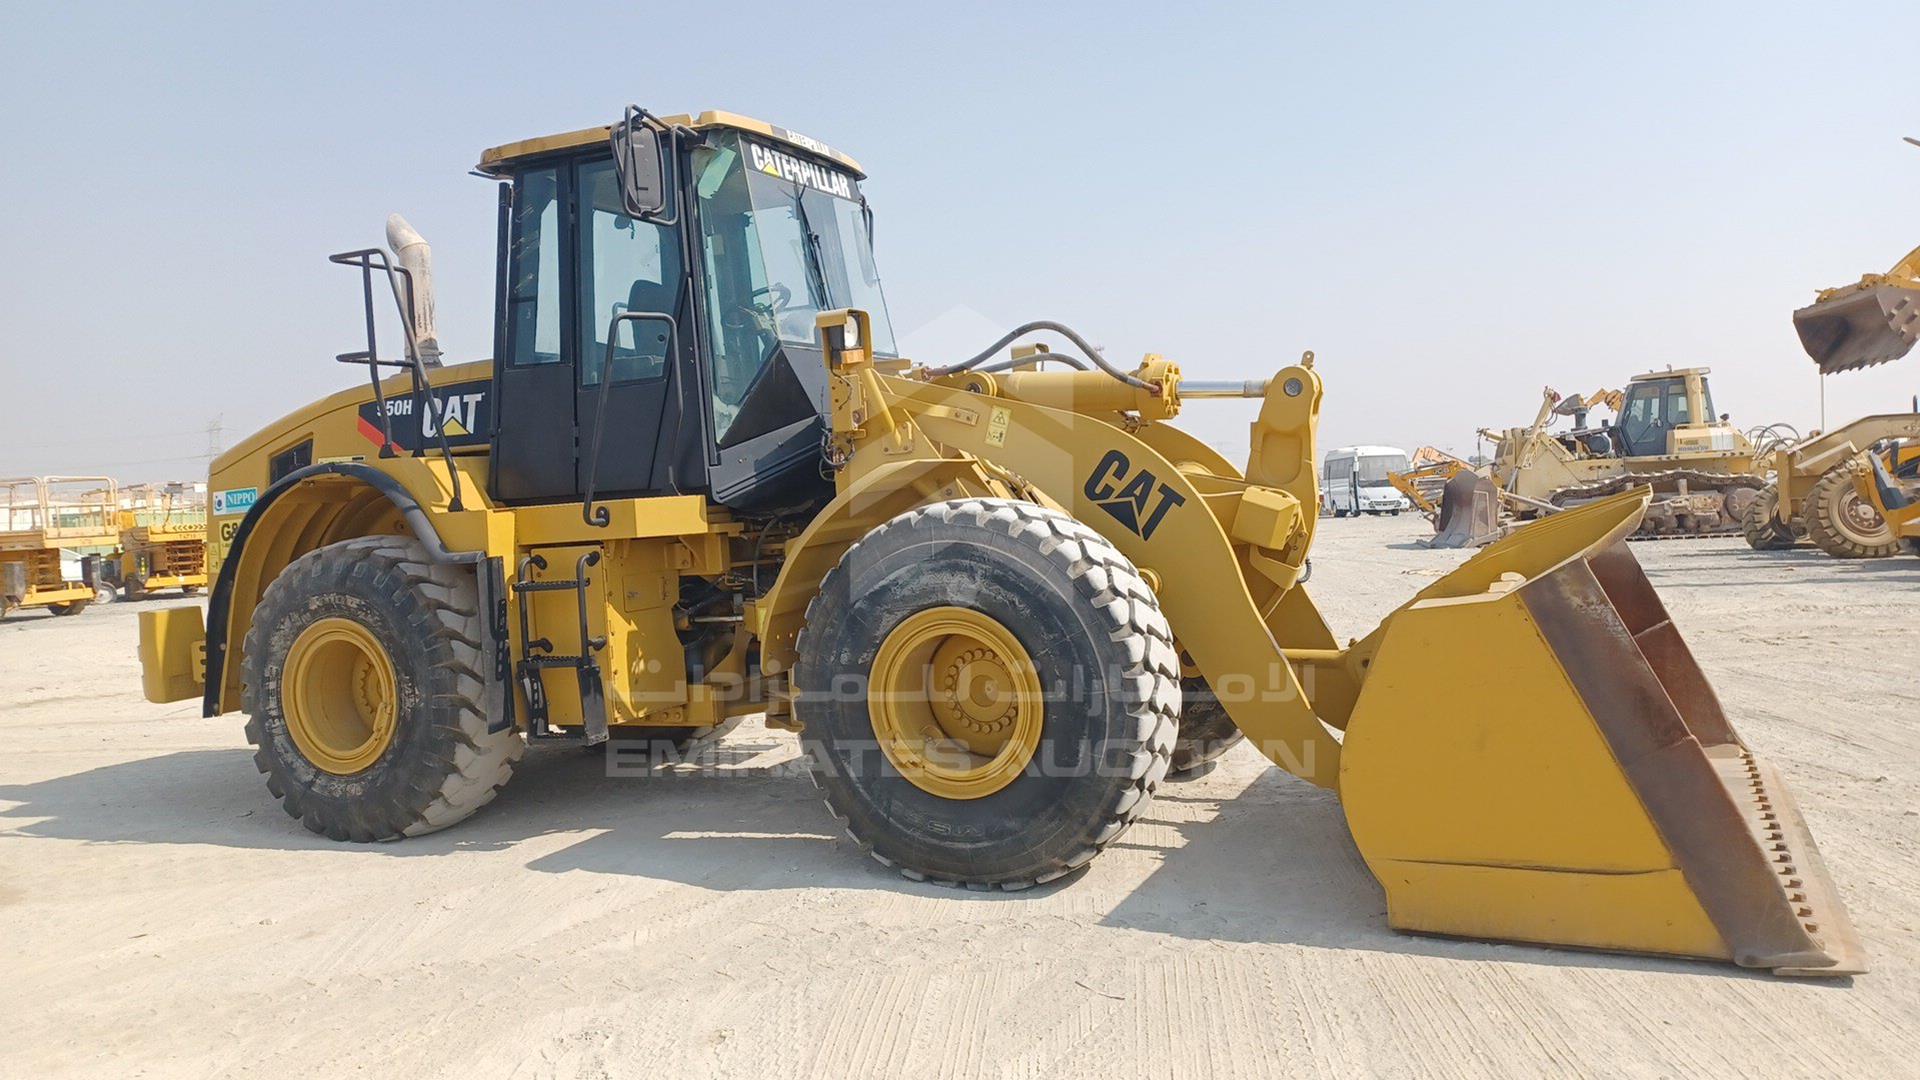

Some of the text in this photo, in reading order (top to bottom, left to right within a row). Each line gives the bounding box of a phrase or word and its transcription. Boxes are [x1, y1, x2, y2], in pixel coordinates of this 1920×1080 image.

[750, 143, 851, 199] CATERPILLAR
[422, 392, 484, 438] CAT
[227, 491, 255, 505] NIPPO
[1084, 449, 1186, 541] CAT
